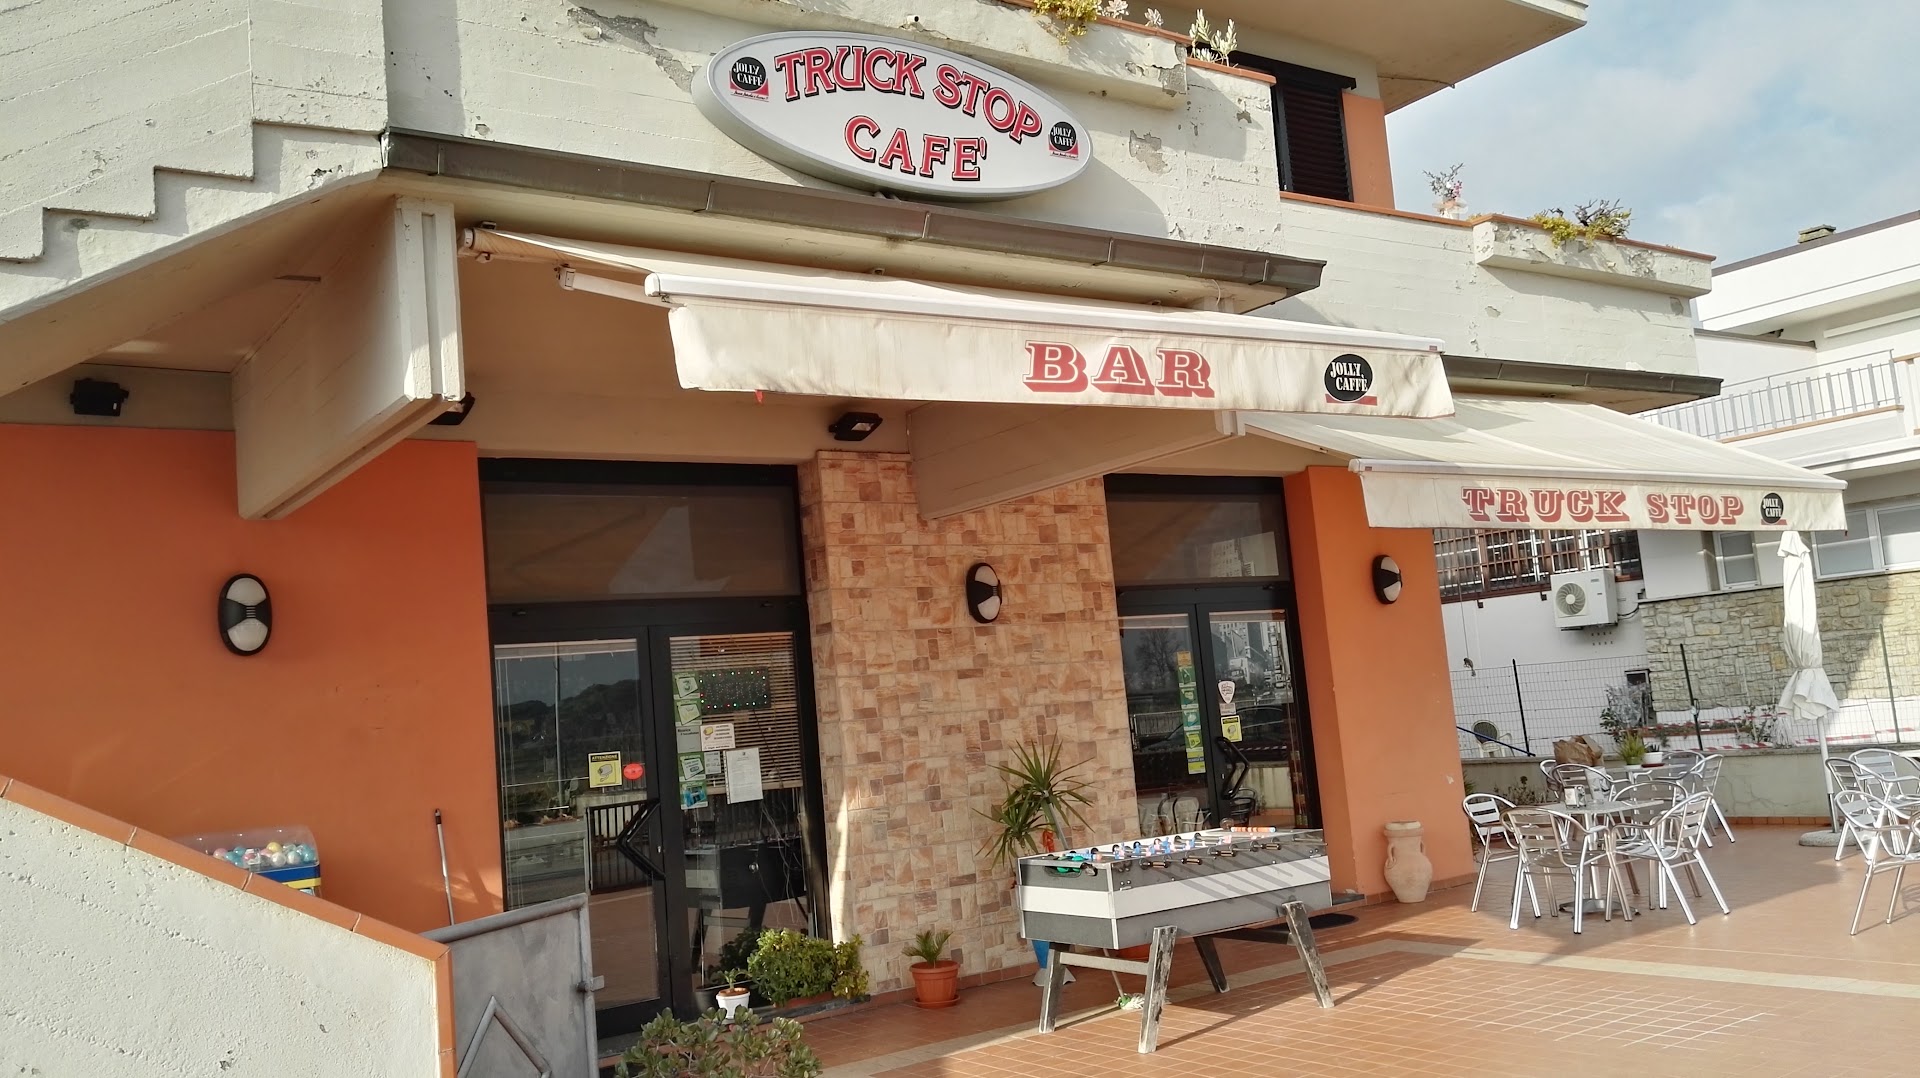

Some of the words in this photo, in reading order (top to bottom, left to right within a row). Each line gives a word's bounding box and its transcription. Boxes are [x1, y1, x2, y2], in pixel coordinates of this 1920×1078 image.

[733, 62, 760, 75] JOLLY
[774, 45, 926, 102] TRUCK
[932, 63, 1043, 143] STOP
[1051, 126, 1071, 138] JOLLY
[1022, 340, 1215, 398] BAR
[1330, 361, 1361, 378] JOLLY
[1335, 373, 1368, 392] CAFFÈ
[1461, 486, 1630, 523] TRUCK
[1647, 492, 1744, 525] STOP
[1763, 498, 1779, 509] JOLLY
